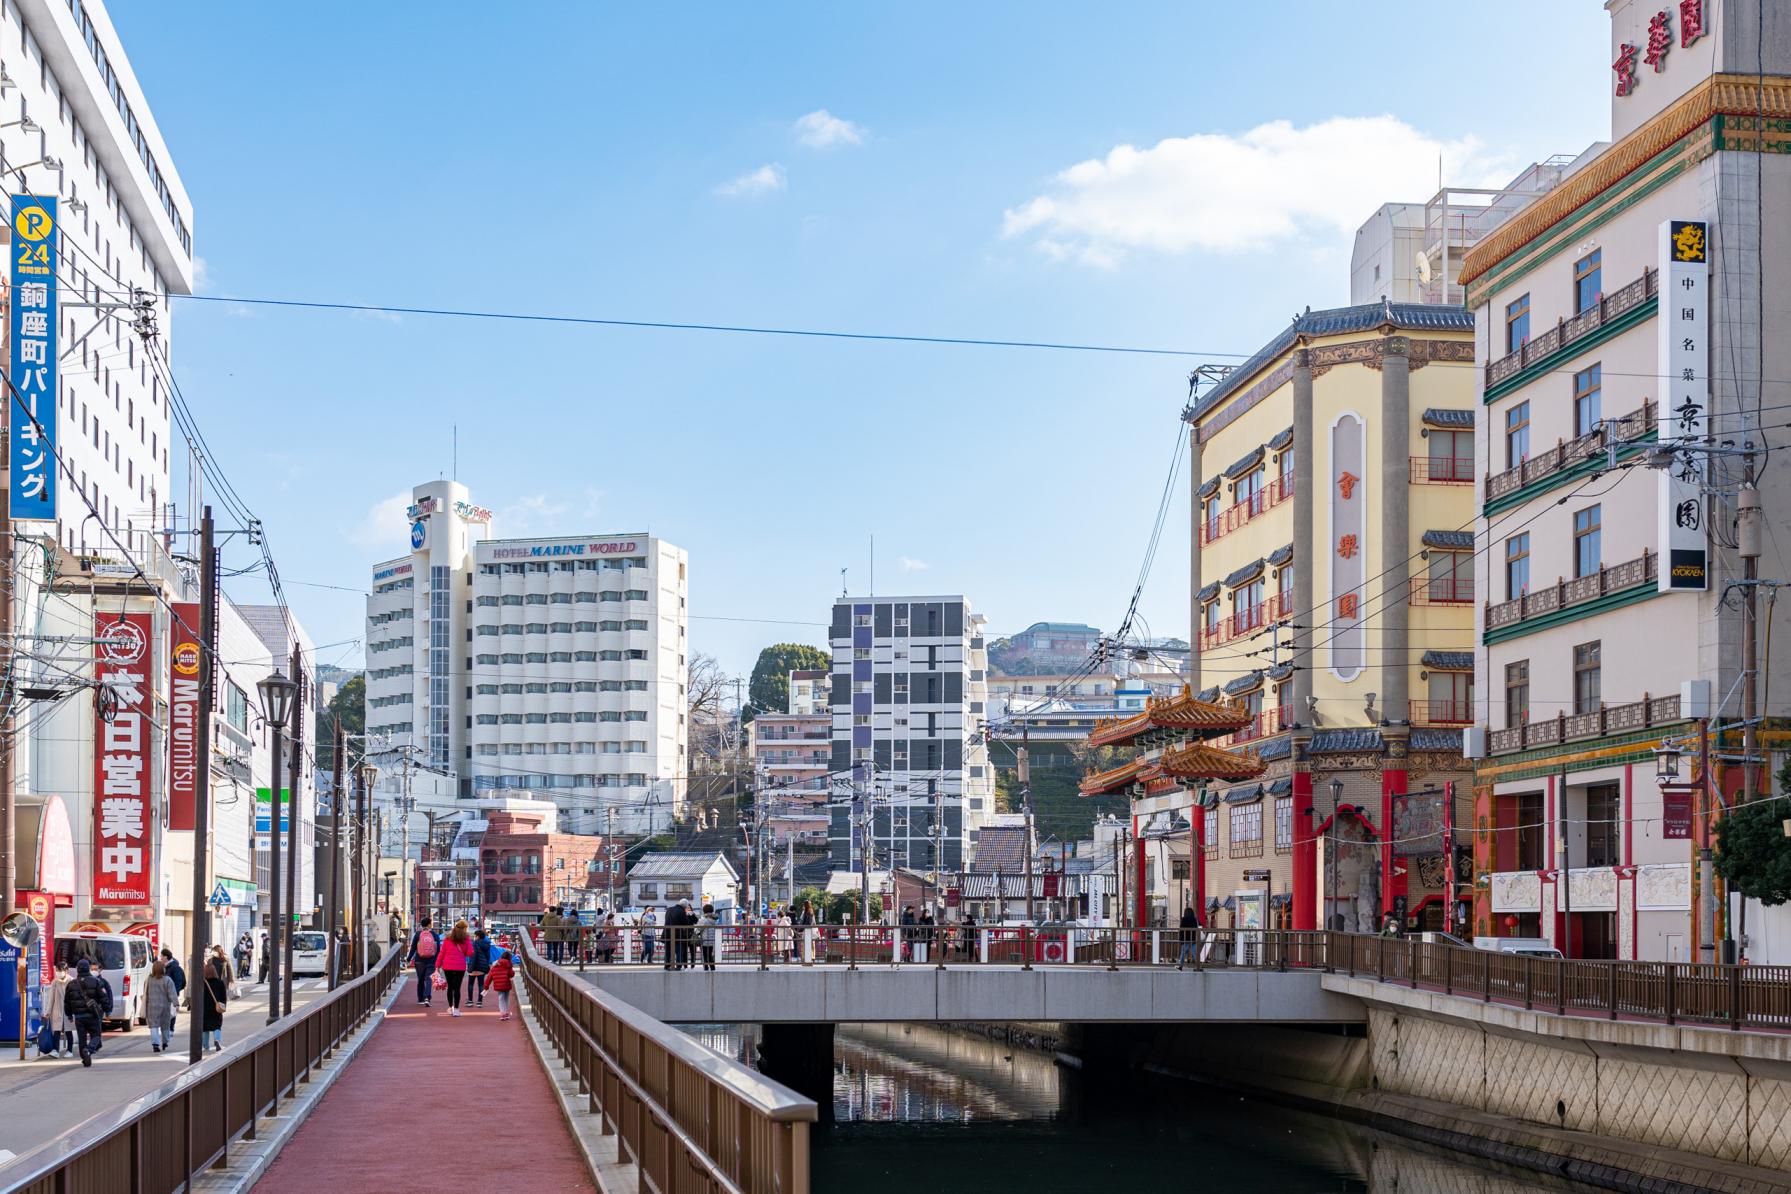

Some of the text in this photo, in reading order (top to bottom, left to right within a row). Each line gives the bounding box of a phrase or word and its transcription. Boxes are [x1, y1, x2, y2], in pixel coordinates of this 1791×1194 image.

[28, 213, 44, 235] P
[18, 243, 49, 264] 24
[1681, 277, 1695, 382] 中国名菜
[20, 281, 48, 498] 銅座町パーキング
[493, 542, 637, 559] HOTEL MARINE WORLD
[1671, 568, 1704, 577] KYOKAEN
[173, 679, 198, 791] Marumitsu
[101, 668, 145, 882] 本日営業中
[99, 888, 145, 900] Marumitsu
